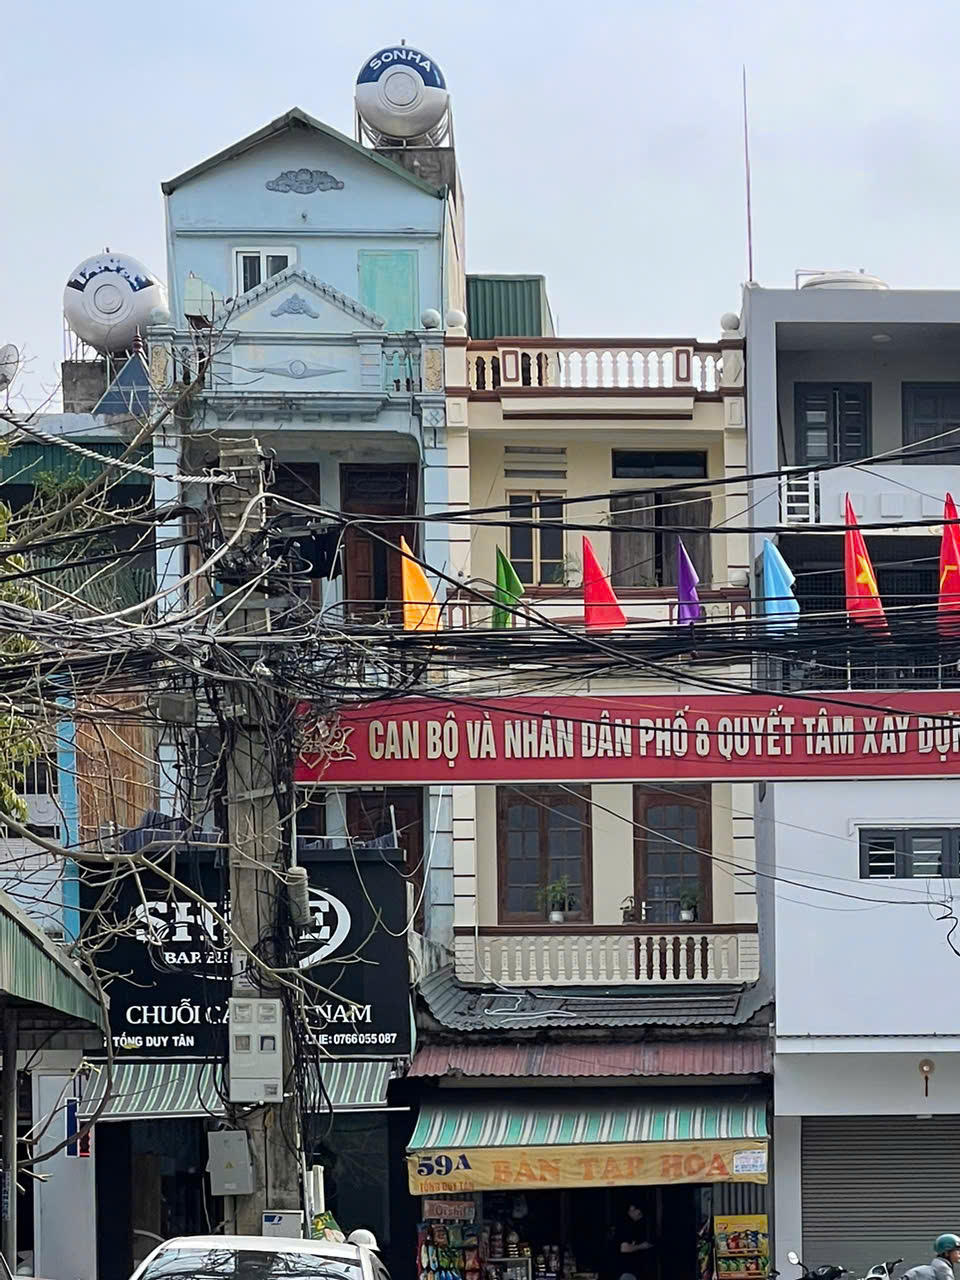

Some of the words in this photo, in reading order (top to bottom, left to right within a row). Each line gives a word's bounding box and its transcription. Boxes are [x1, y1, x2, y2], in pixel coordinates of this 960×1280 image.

[369, 50, 432, 72] SONHA
[427, 711, 459, 768] BỘ
[466, 711, 497, 759] VÀ
[504, 711, 574, 759] NHÂN
[581, 710, 632, 758] DÂN
[640, 705, 688, 757] PHỐ
[695, 718, 710, 756] 8
[717, 705, 795, 760] QUYẾT
[803, 708, 855, 755] TÂM
[125, 998, 200, 1024] CHUỖI
[113, 1031, 143, 1047] TỐNG
[145, 1036, 169, 1047] DUY
[171, 1033, 195, 1047] TÂN
[333, 1033, 358, 1045] 0766
[358, 1033, 378, 1045] 055
[378, 1033, 398, 1044] 087
[417, 1154, 473, 1177] 59A
